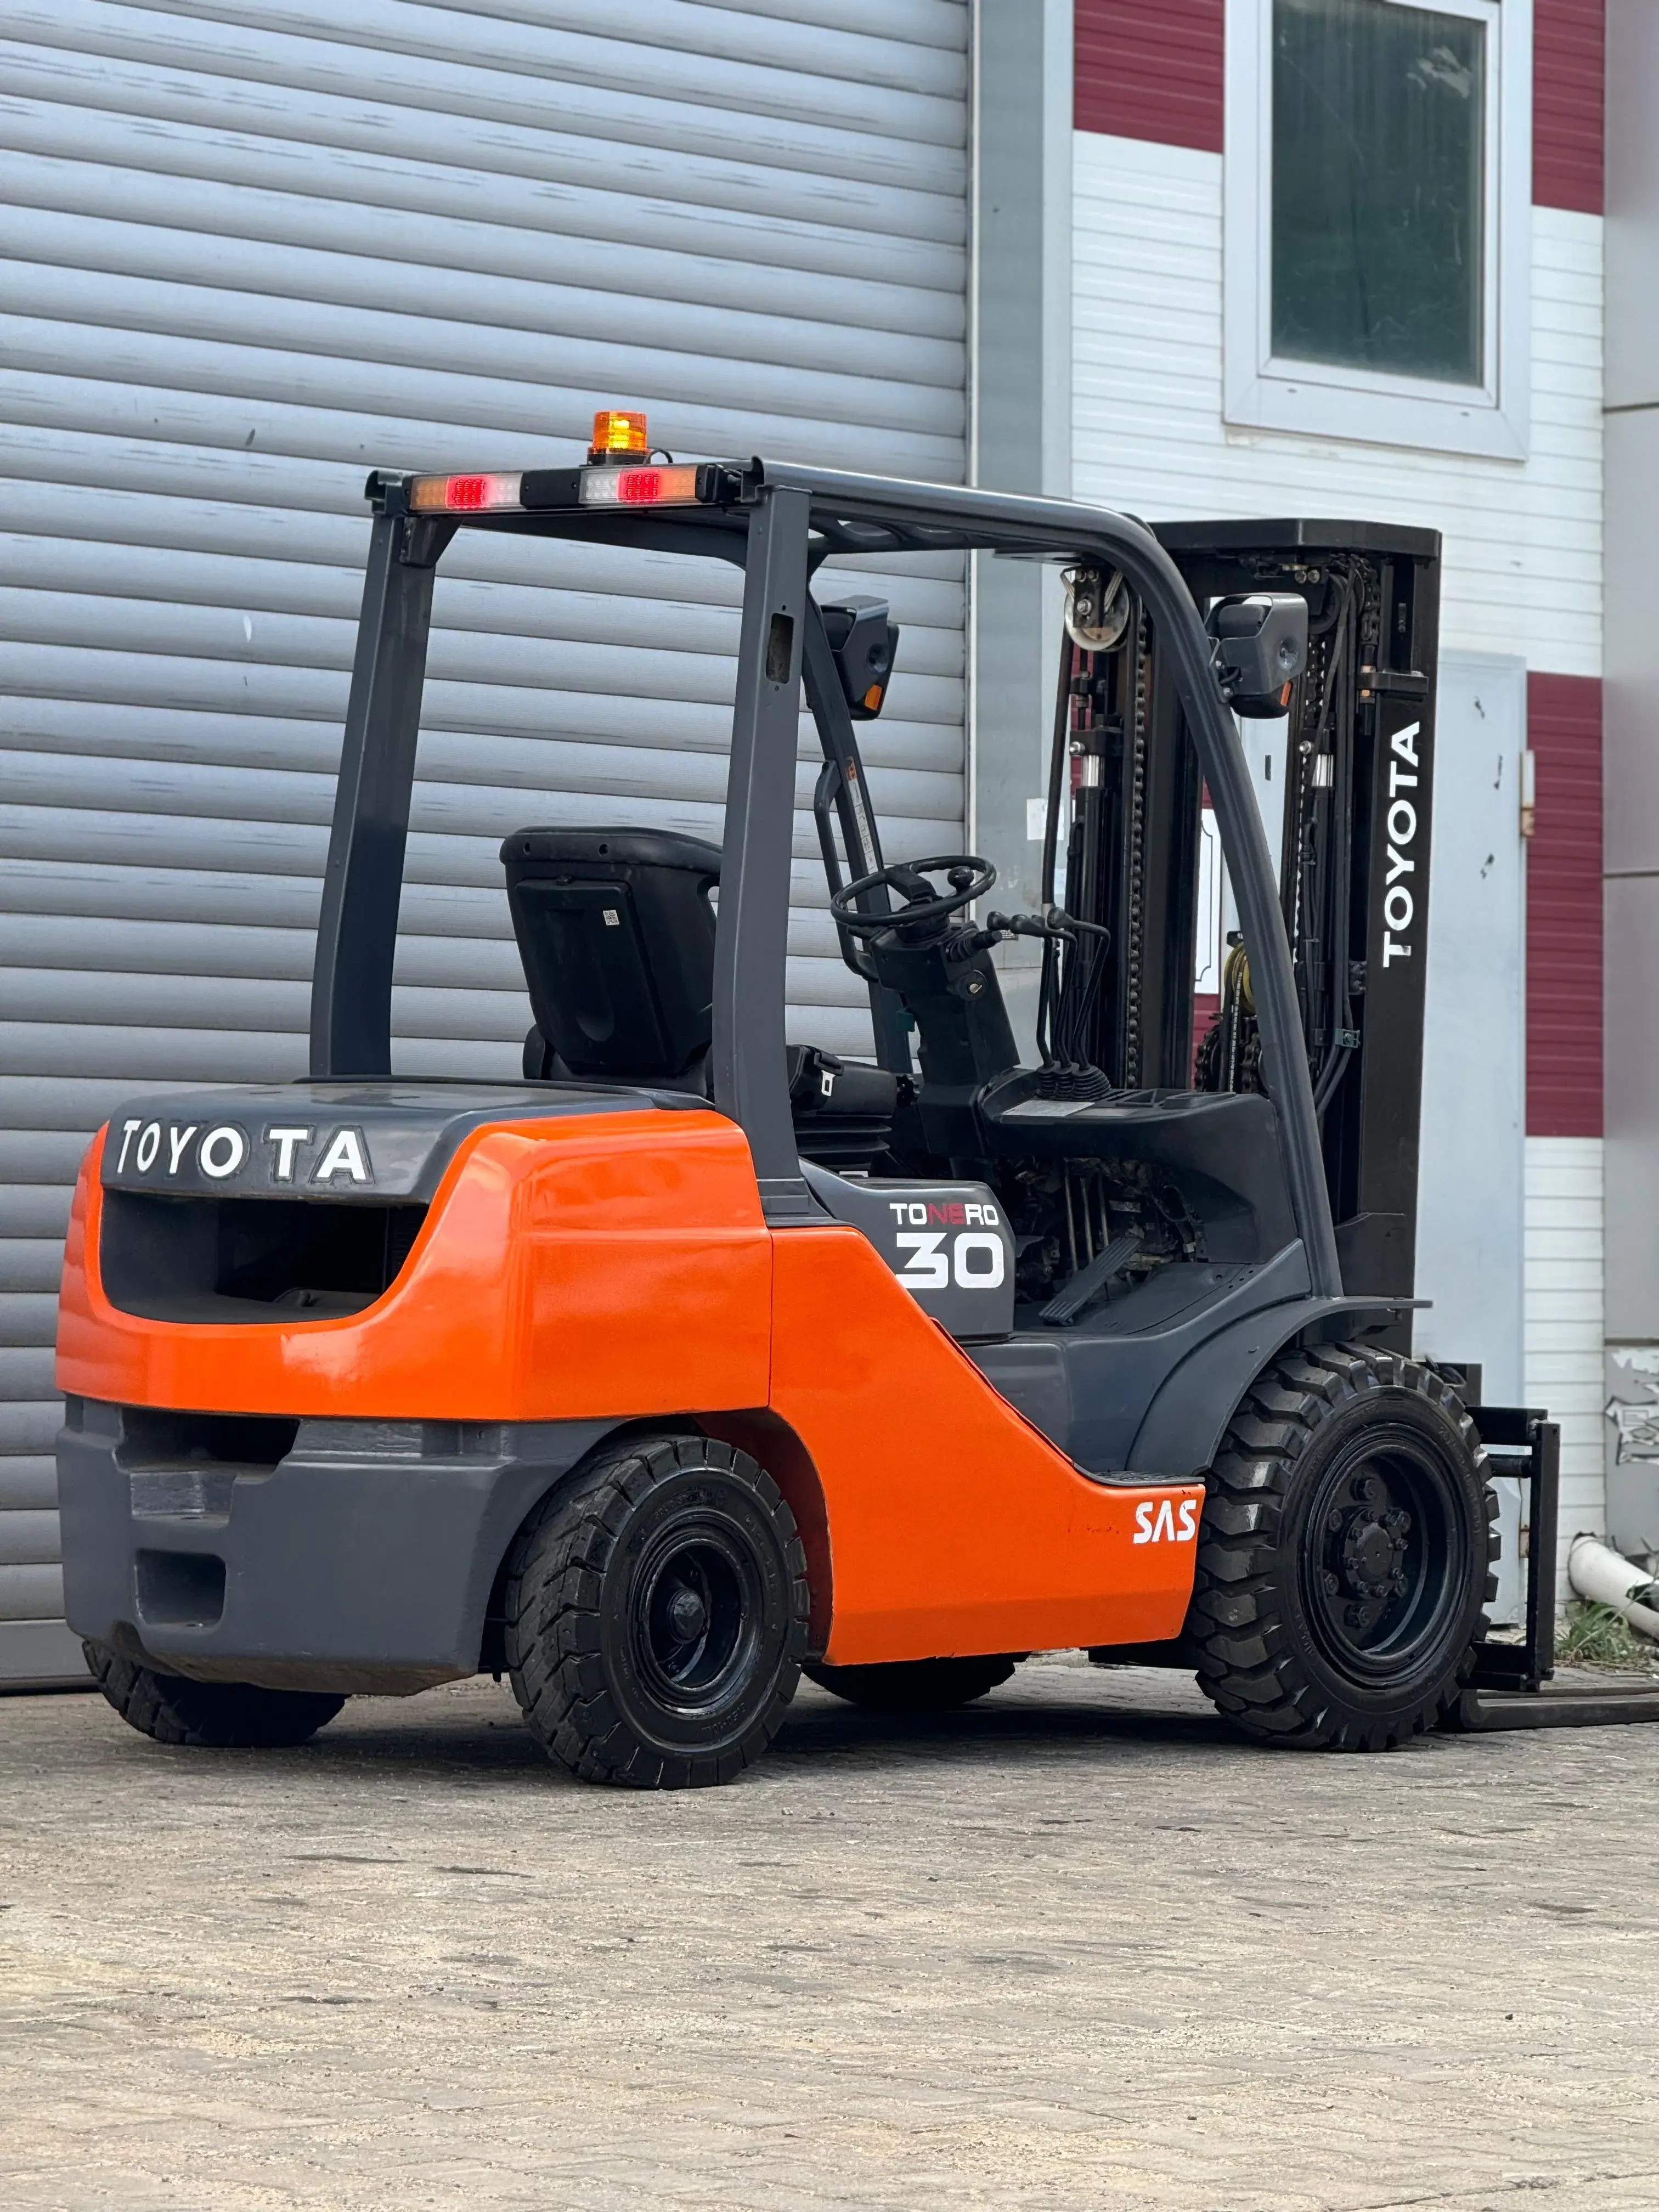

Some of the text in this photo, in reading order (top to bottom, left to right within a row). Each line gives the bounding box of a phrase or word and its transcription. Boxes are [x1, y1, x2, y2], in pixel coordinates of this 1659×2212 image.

[1383, 721, 1420, 968] TOYOTA
[117, 1120, 366, 1180] TOYOTA
[889, 1203, 999, 1226] TONERO
[895, 1232, 1004, 1288] 30
[1133, 1499, 1197, 1544] SAS
